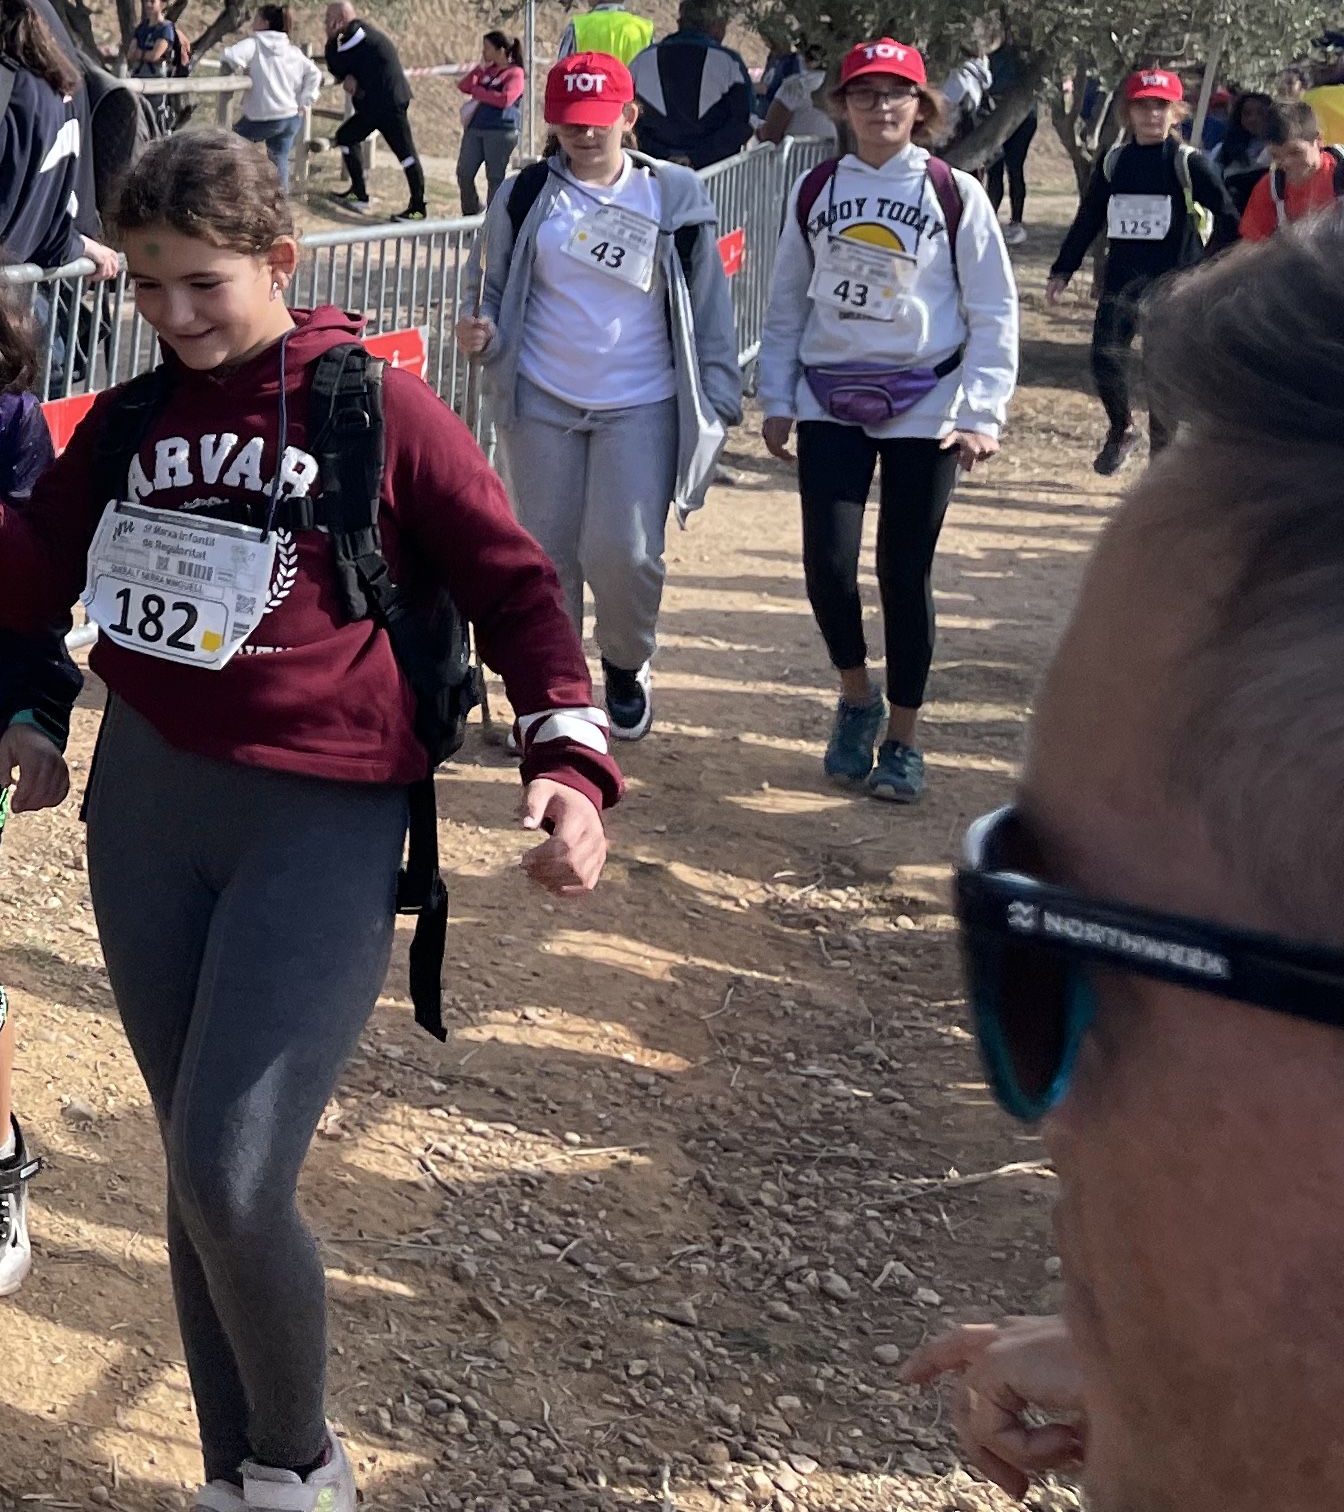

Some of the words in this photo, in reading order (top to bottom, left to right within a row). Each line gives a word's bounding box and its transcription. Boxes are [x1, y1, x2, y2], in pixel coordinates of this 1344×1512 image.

[863, 44, 907, 63] TOT
[563, 72, 608, 93] TOT
[877, 197, 944, 240] TODAY
[591, 241, 626, 268] 43
[833, 280, 869, 307] 43
[127, 432, 319, 502] ARVAR
[109, 587, 199, 652] 182
